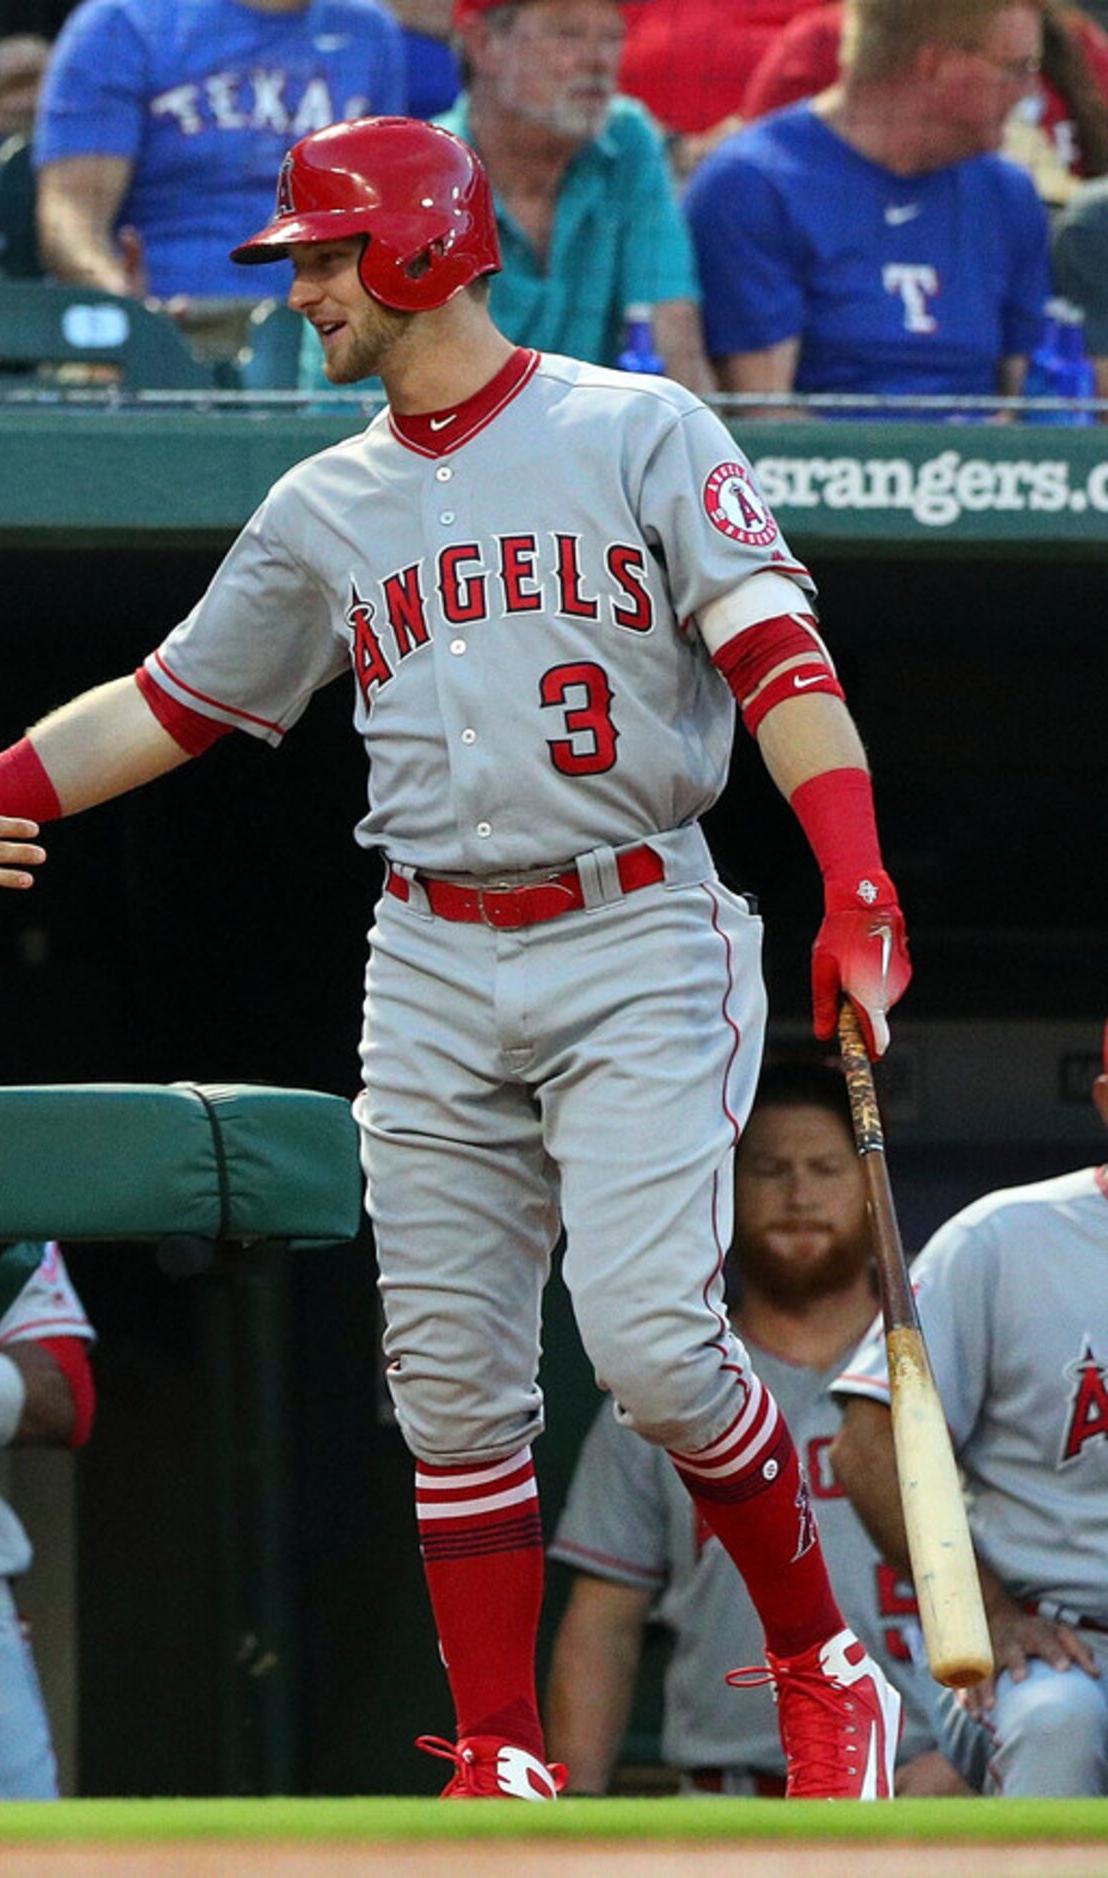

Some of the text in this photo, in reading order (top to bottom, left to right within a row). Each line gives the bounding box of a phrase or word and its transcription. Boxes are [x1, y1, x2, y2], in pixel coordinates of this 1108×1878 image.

[881, 261, 939, 334] T
[345, 531, 654, 723] ANGELS
[538, 660, 620, 778] 3
